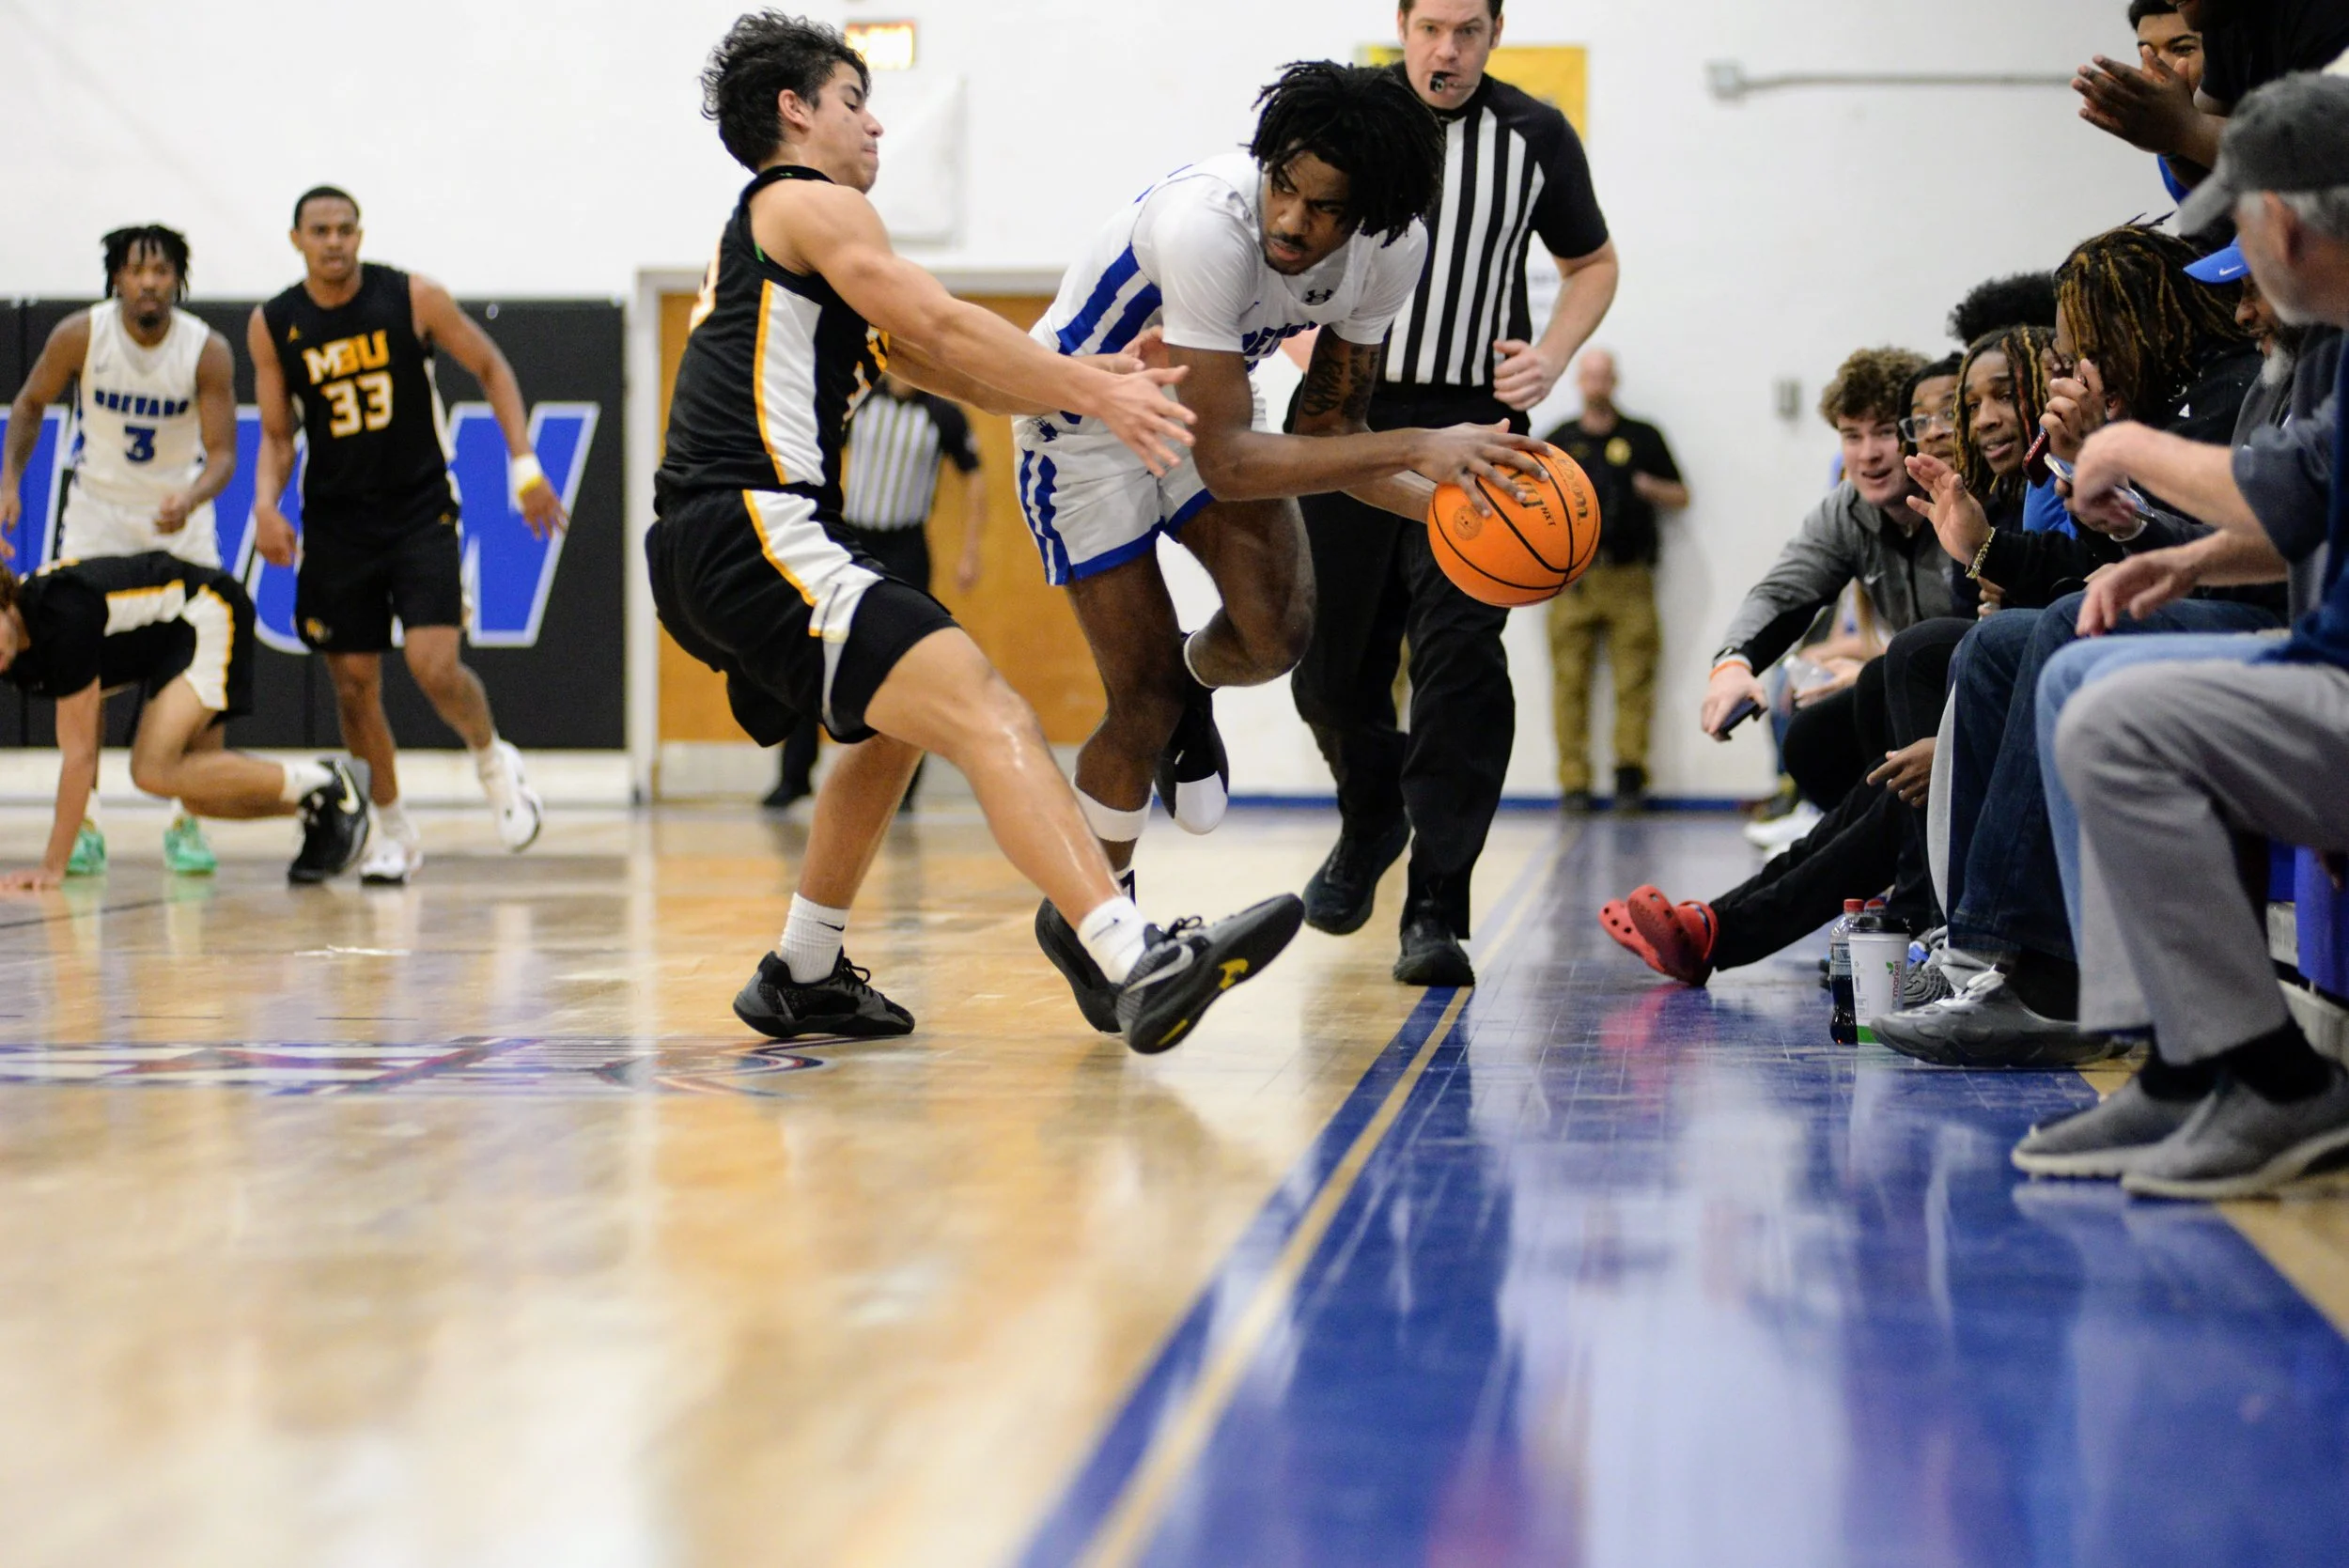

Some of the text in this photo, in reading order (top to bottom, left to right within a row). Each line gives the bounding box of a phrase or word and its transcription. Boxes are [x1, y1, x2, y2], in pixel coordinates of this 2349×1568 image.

[302, 329, 390, 385] MBU
[320, 370, 393, 439] 33
[124, 425, 156, 462] 3
[1540, 506, 1556, 526] NXT
